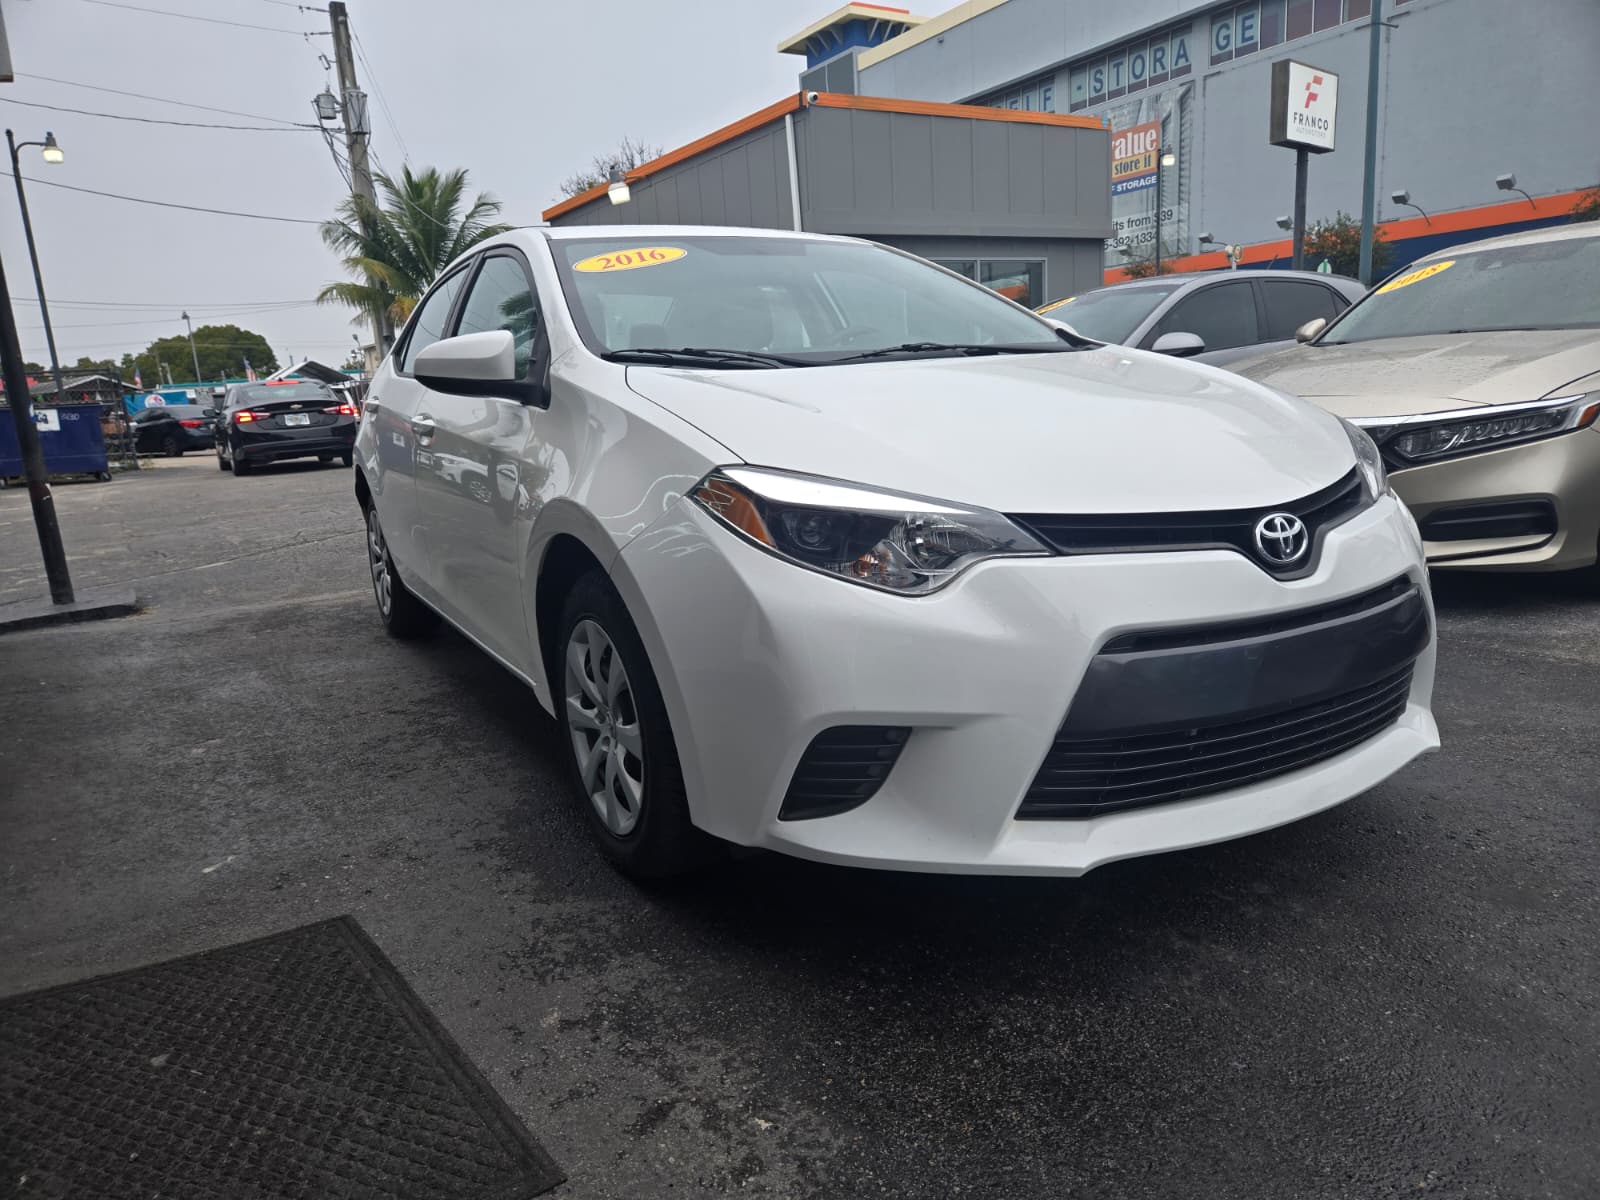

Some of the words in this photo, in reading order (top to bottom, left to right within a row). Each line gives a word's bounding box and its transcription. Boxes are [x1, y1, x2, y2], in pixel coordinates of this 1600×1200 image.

[1293, 112, 1329, 131] FRANCO
[1112, 128, 1157, 160] alue
[1114, 158, 1140, 175] store
[1116, 175, 1157, 192] STORAGE
[1112, 219, 1124, 231] its
[1127, 215, 1151, 229] from
[596, 249, 666, 270] 2016
